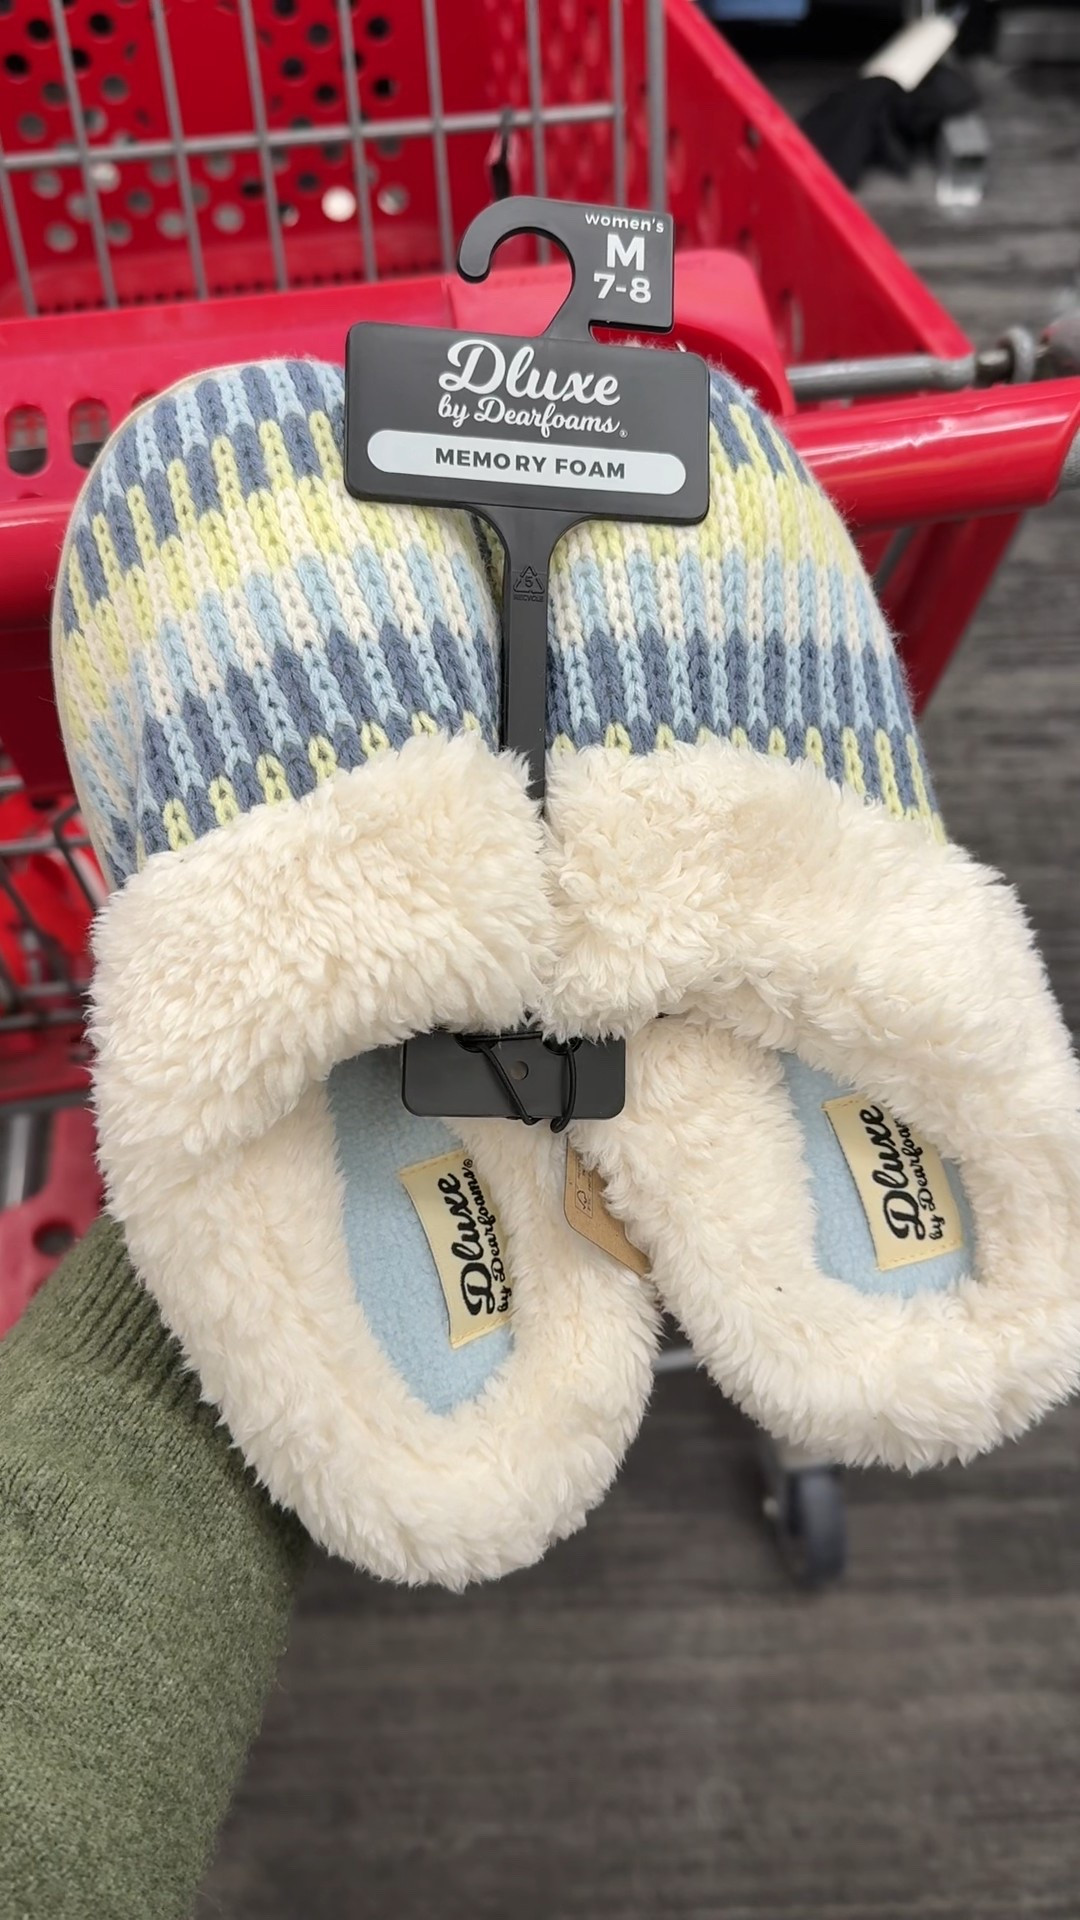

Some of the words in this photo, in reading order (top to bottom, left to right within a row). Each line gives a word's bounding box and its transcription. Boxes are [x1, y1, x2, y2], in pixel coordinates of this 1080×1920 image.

[585, 212, 664, 233] women's
[606, 233, 645, 271] M
[593, 271, 651, 304] 7-8
[438, 339, 621, 406] Dluxe
[438, 394, 470, 428] by
[435, 448, 547, 473] MEMORY
[555, 458, 626, 479] FOAM
[524, 575, 534, 588] 5
[859, 1104, 926, 1241] Dluxe
[893, 1118, 936, 1212] Dearfoa
[437, 1172, 496, 1316] Dluxe
[929, 1214, 946, 1241] by
[497, 1285, 512, 1313] by
